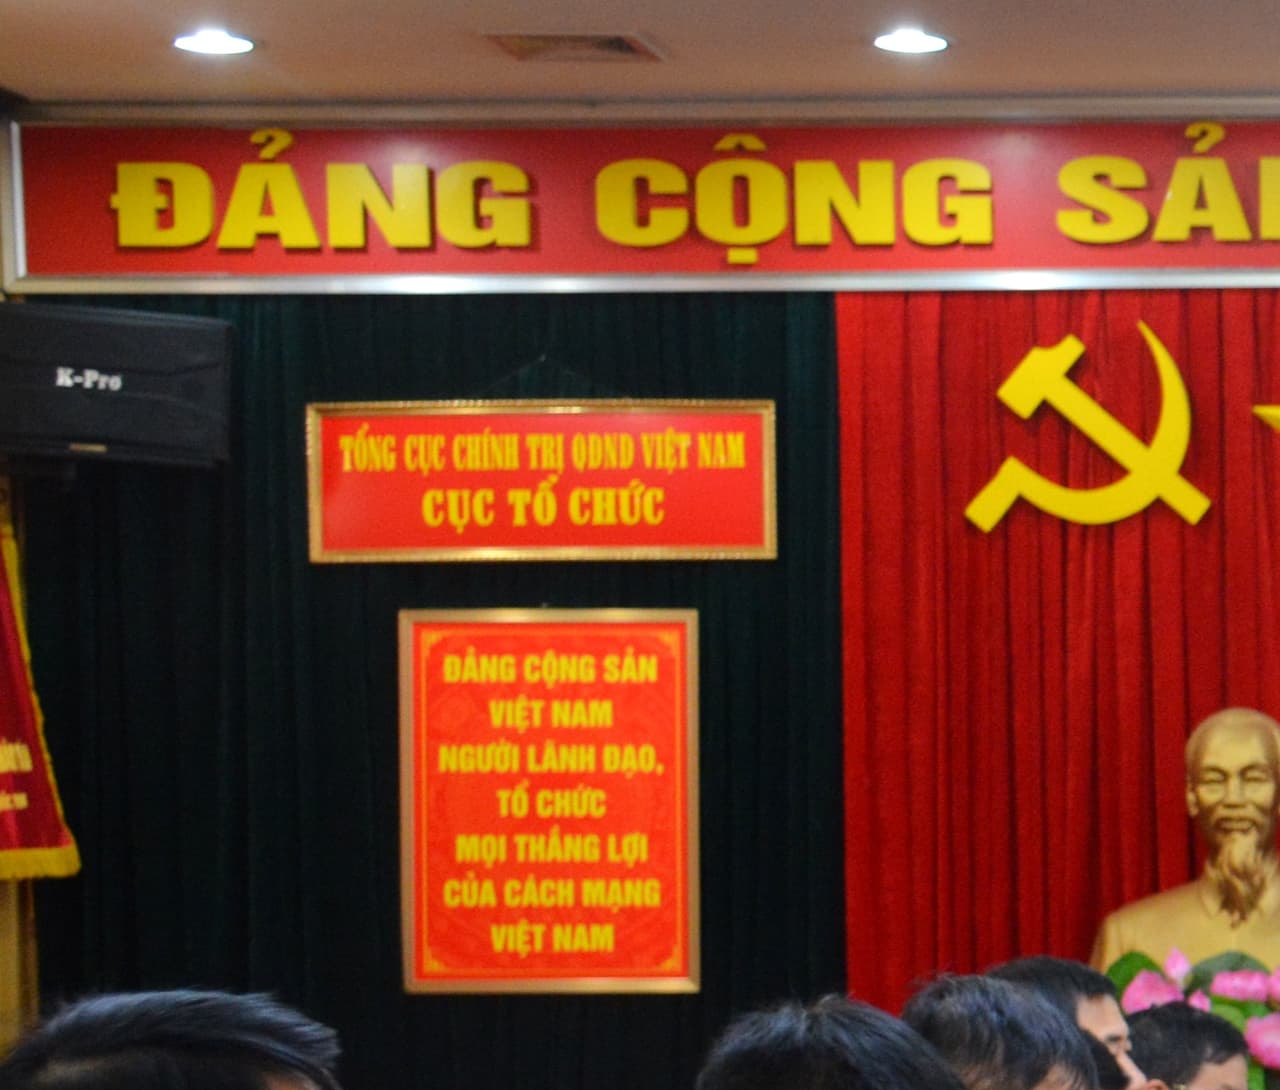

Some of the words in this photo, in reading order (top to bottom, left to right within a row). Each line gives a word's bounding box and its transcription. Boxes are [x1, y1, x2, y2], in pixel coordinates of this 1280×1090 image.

[110, 127, 535, 252] ĐẢNG
[595, 135, 995, 265] CỘNG
[55, 366, 123, 392] K-Pro
[405, 435, 445, 475] CỤC
[454, 428, 519, 470] CHÍNH
[527, 434, 564, 474] TRỊ
[641, 427, 691, 474] VIỆT
[698, 432, 745, 468] NAM
[422, 489, 495, 534] CỤC
[569, 479, 664, 525] CHỨC
[444, 647, 516, 683] ĐẢNG
[524, 650, 596, 688] CỘNG
[604, 647, 658, 683] SẢN
[490, 695, 544, 732] VIỆT
[552, 699, 613, 727] NAM
[439, 740, 519, 772] NGƯỜI
[536, 784, 606, 817] CHỨC
[457, 835, 507, 867] MỌI
[504, 874, 575, 907] CÁCH
[582, 879, 661, 912] MẠNG
[492, 920, 545, 957] VIỆT
[554, 925, 614, 952] NAM
